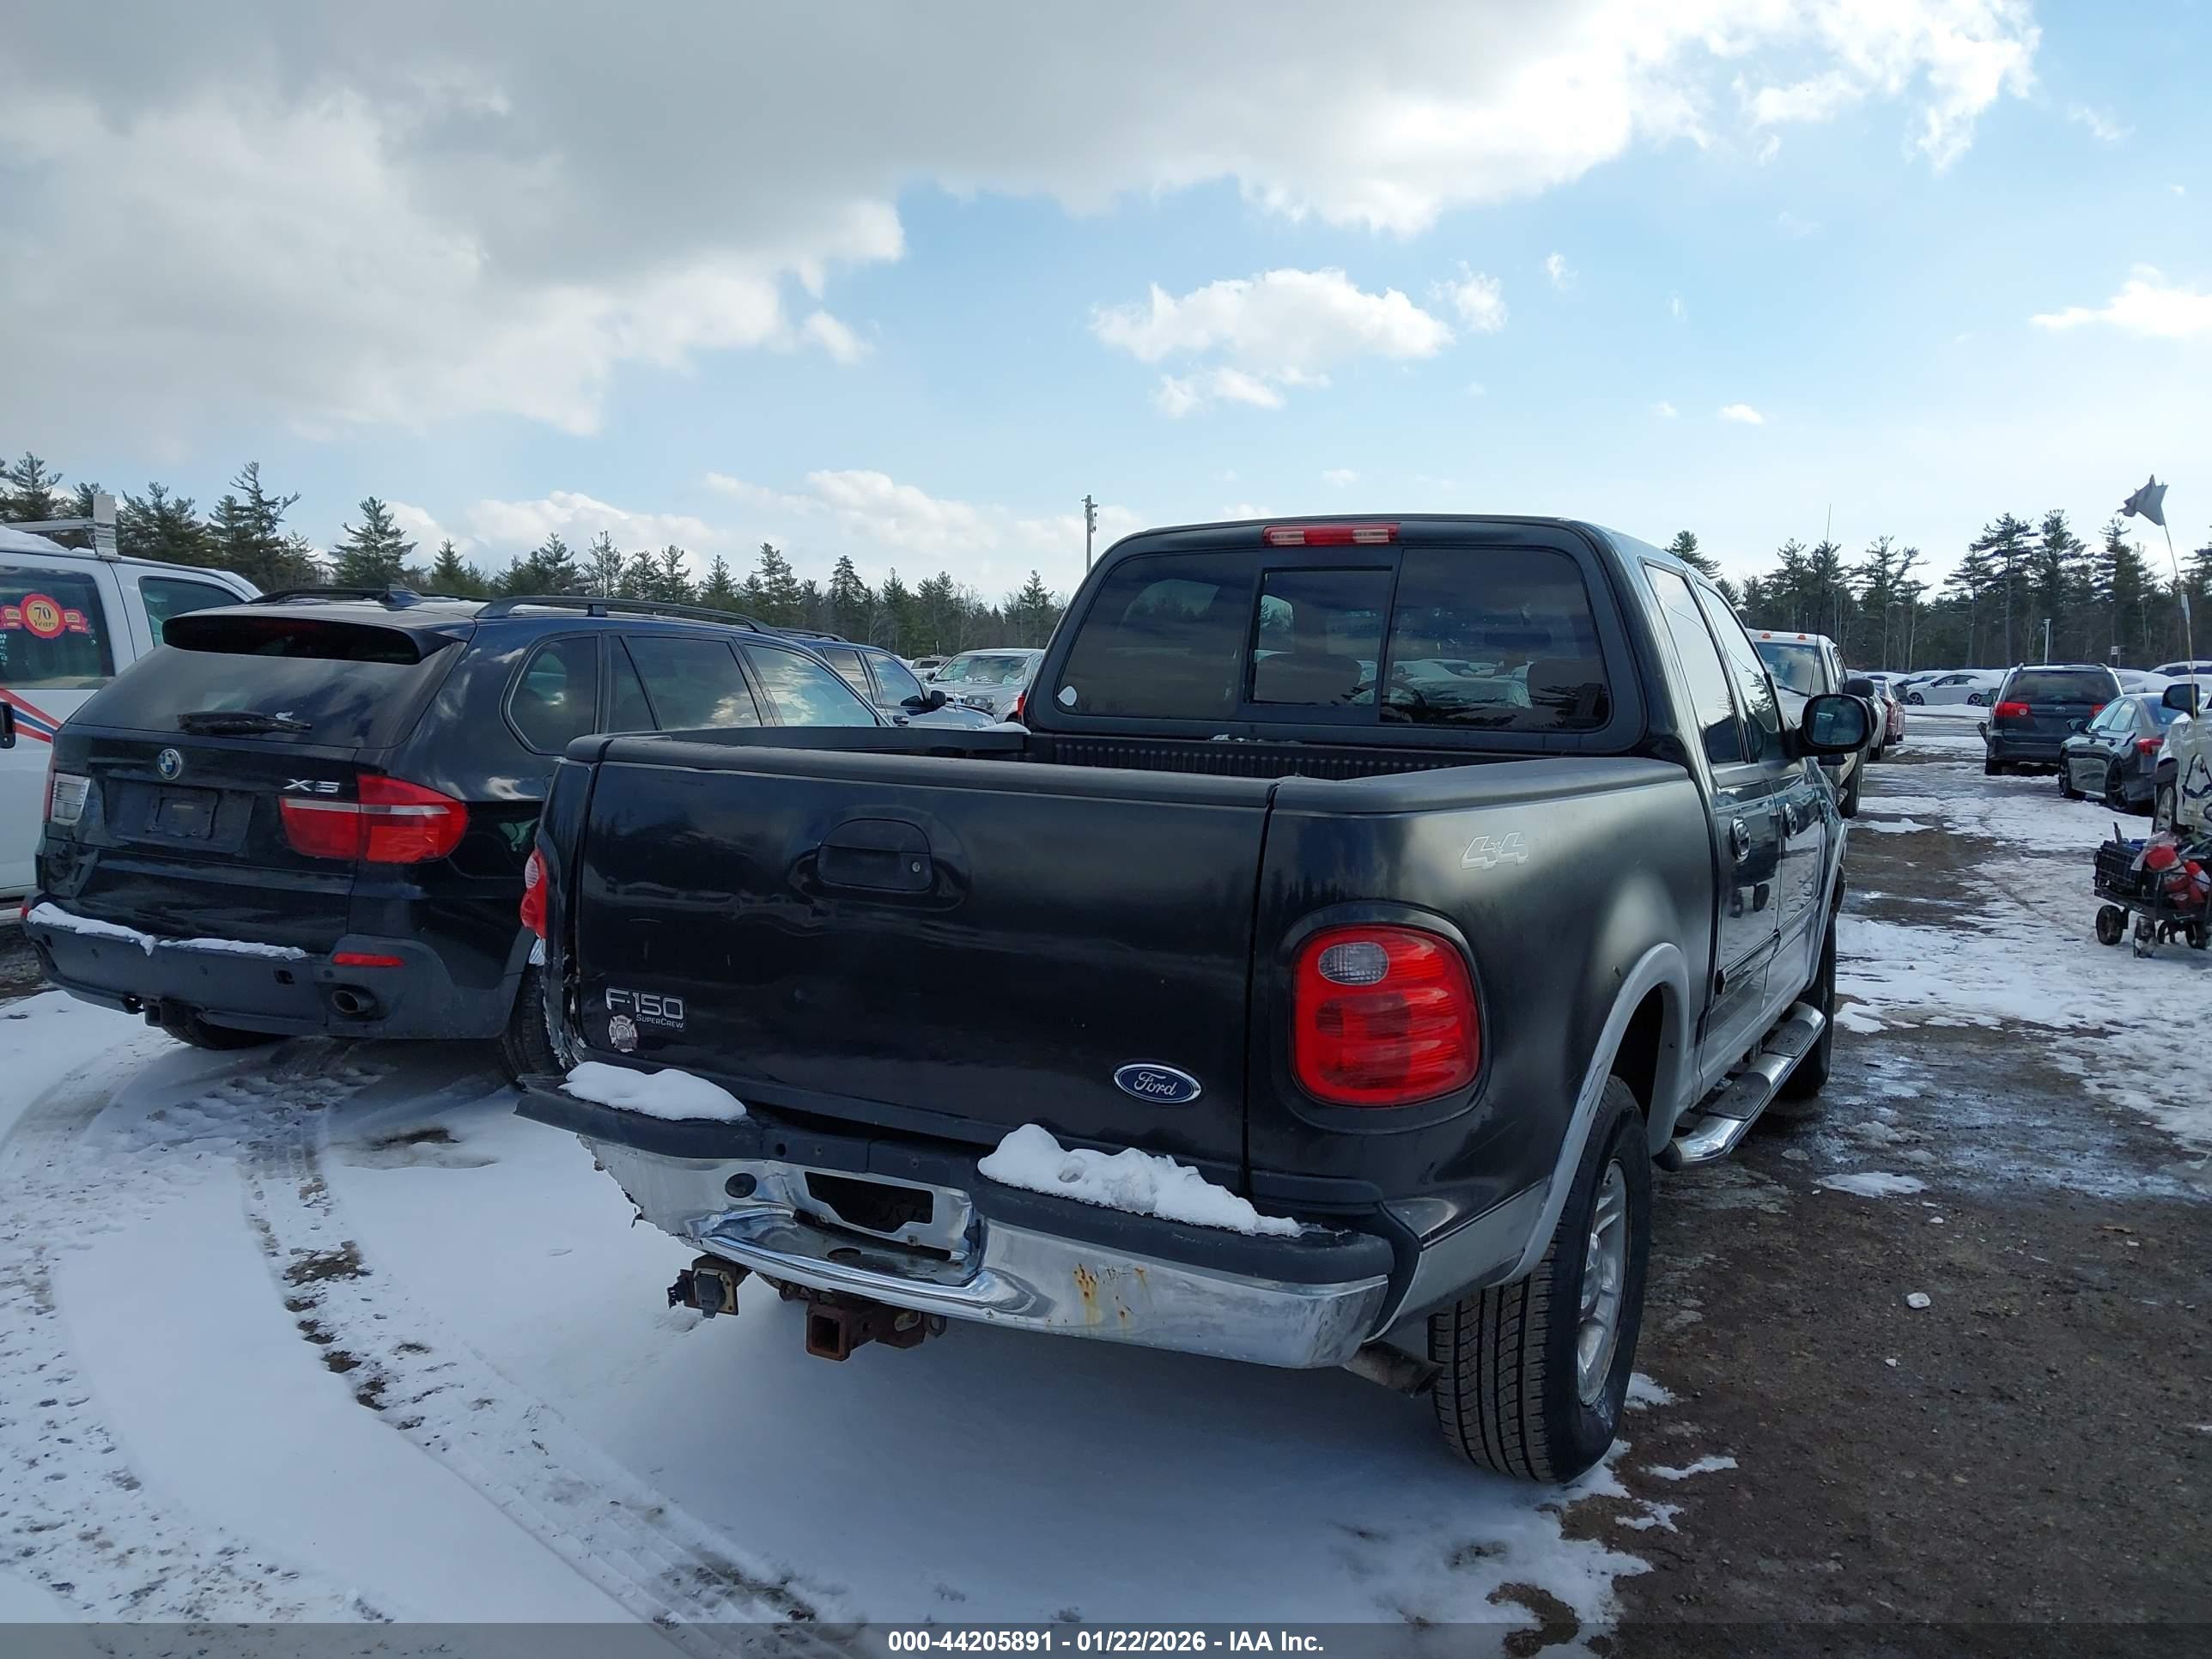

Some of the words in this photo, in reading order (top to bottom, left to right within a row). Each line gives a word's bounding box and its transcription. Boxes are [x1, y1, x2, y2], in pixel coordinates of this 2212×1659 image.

[34, 606, 52, 619] 70
[34, 618, 56, 628] Years
[283, 778, 340, 793] X5
[1133, 1072, 1178, 1096] Ford
